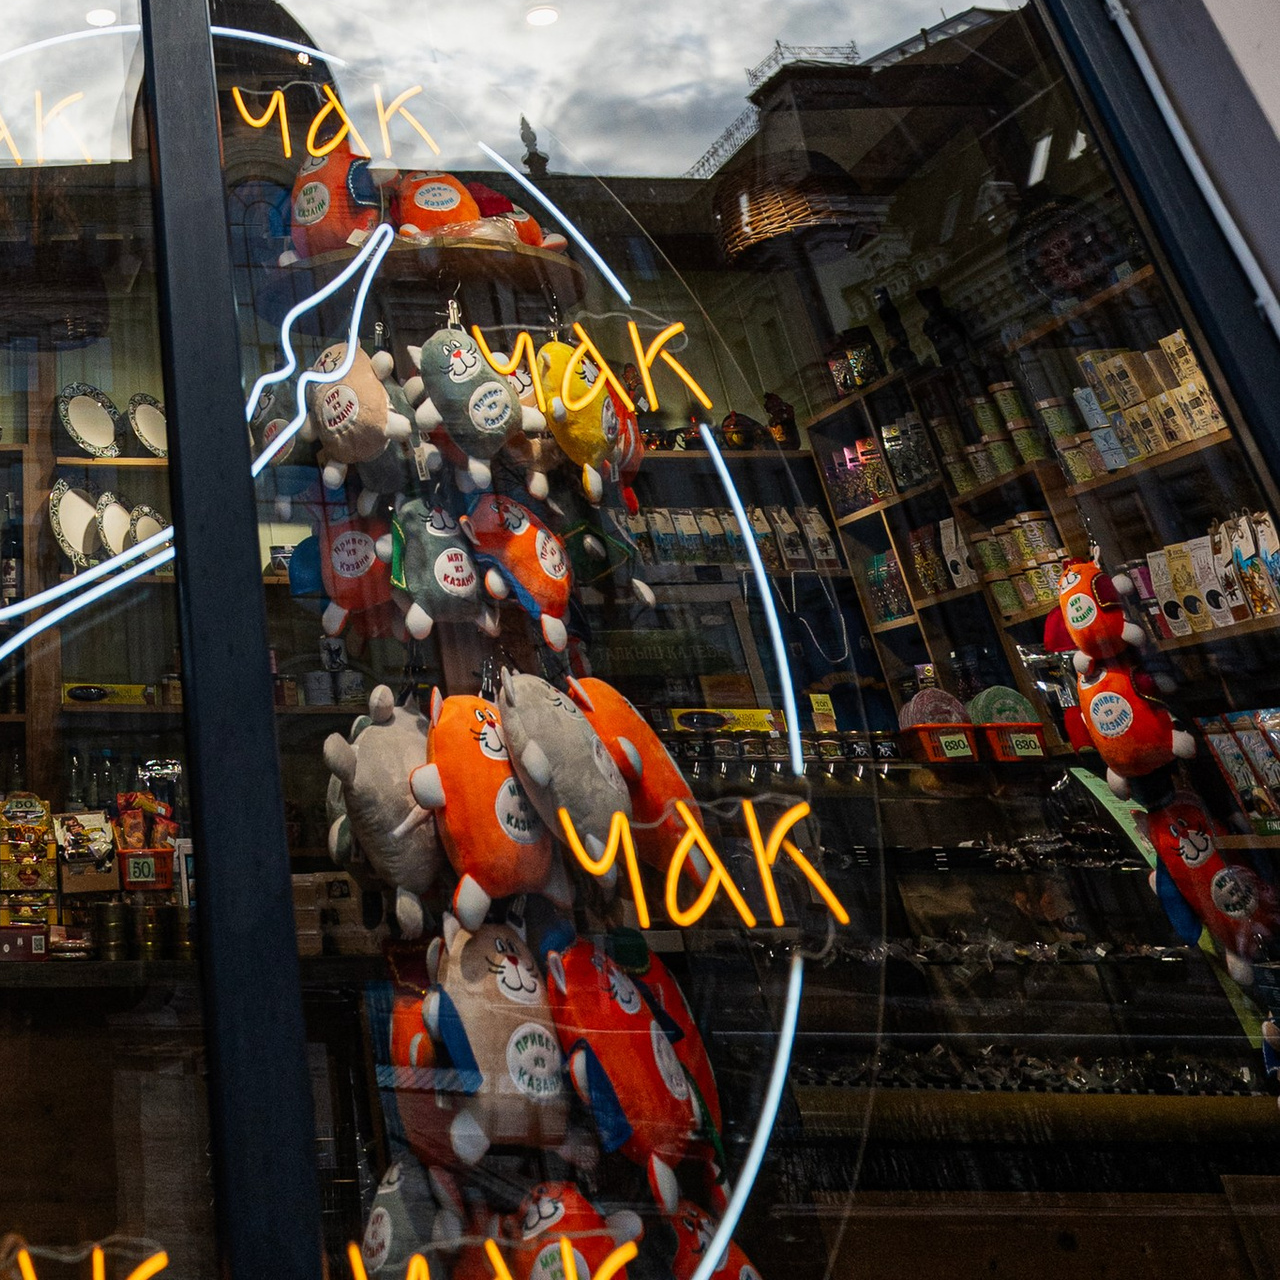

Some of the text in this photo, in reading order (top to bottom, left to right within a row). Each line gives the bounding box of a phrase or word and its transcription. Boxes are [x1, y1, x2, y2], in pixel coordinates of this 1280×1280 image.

[327, 400, 355, 428] КАЗАНИ
[446, 552, 464, 563] МЯУ
[443, 573, 476, 587] КАЗАНИ
